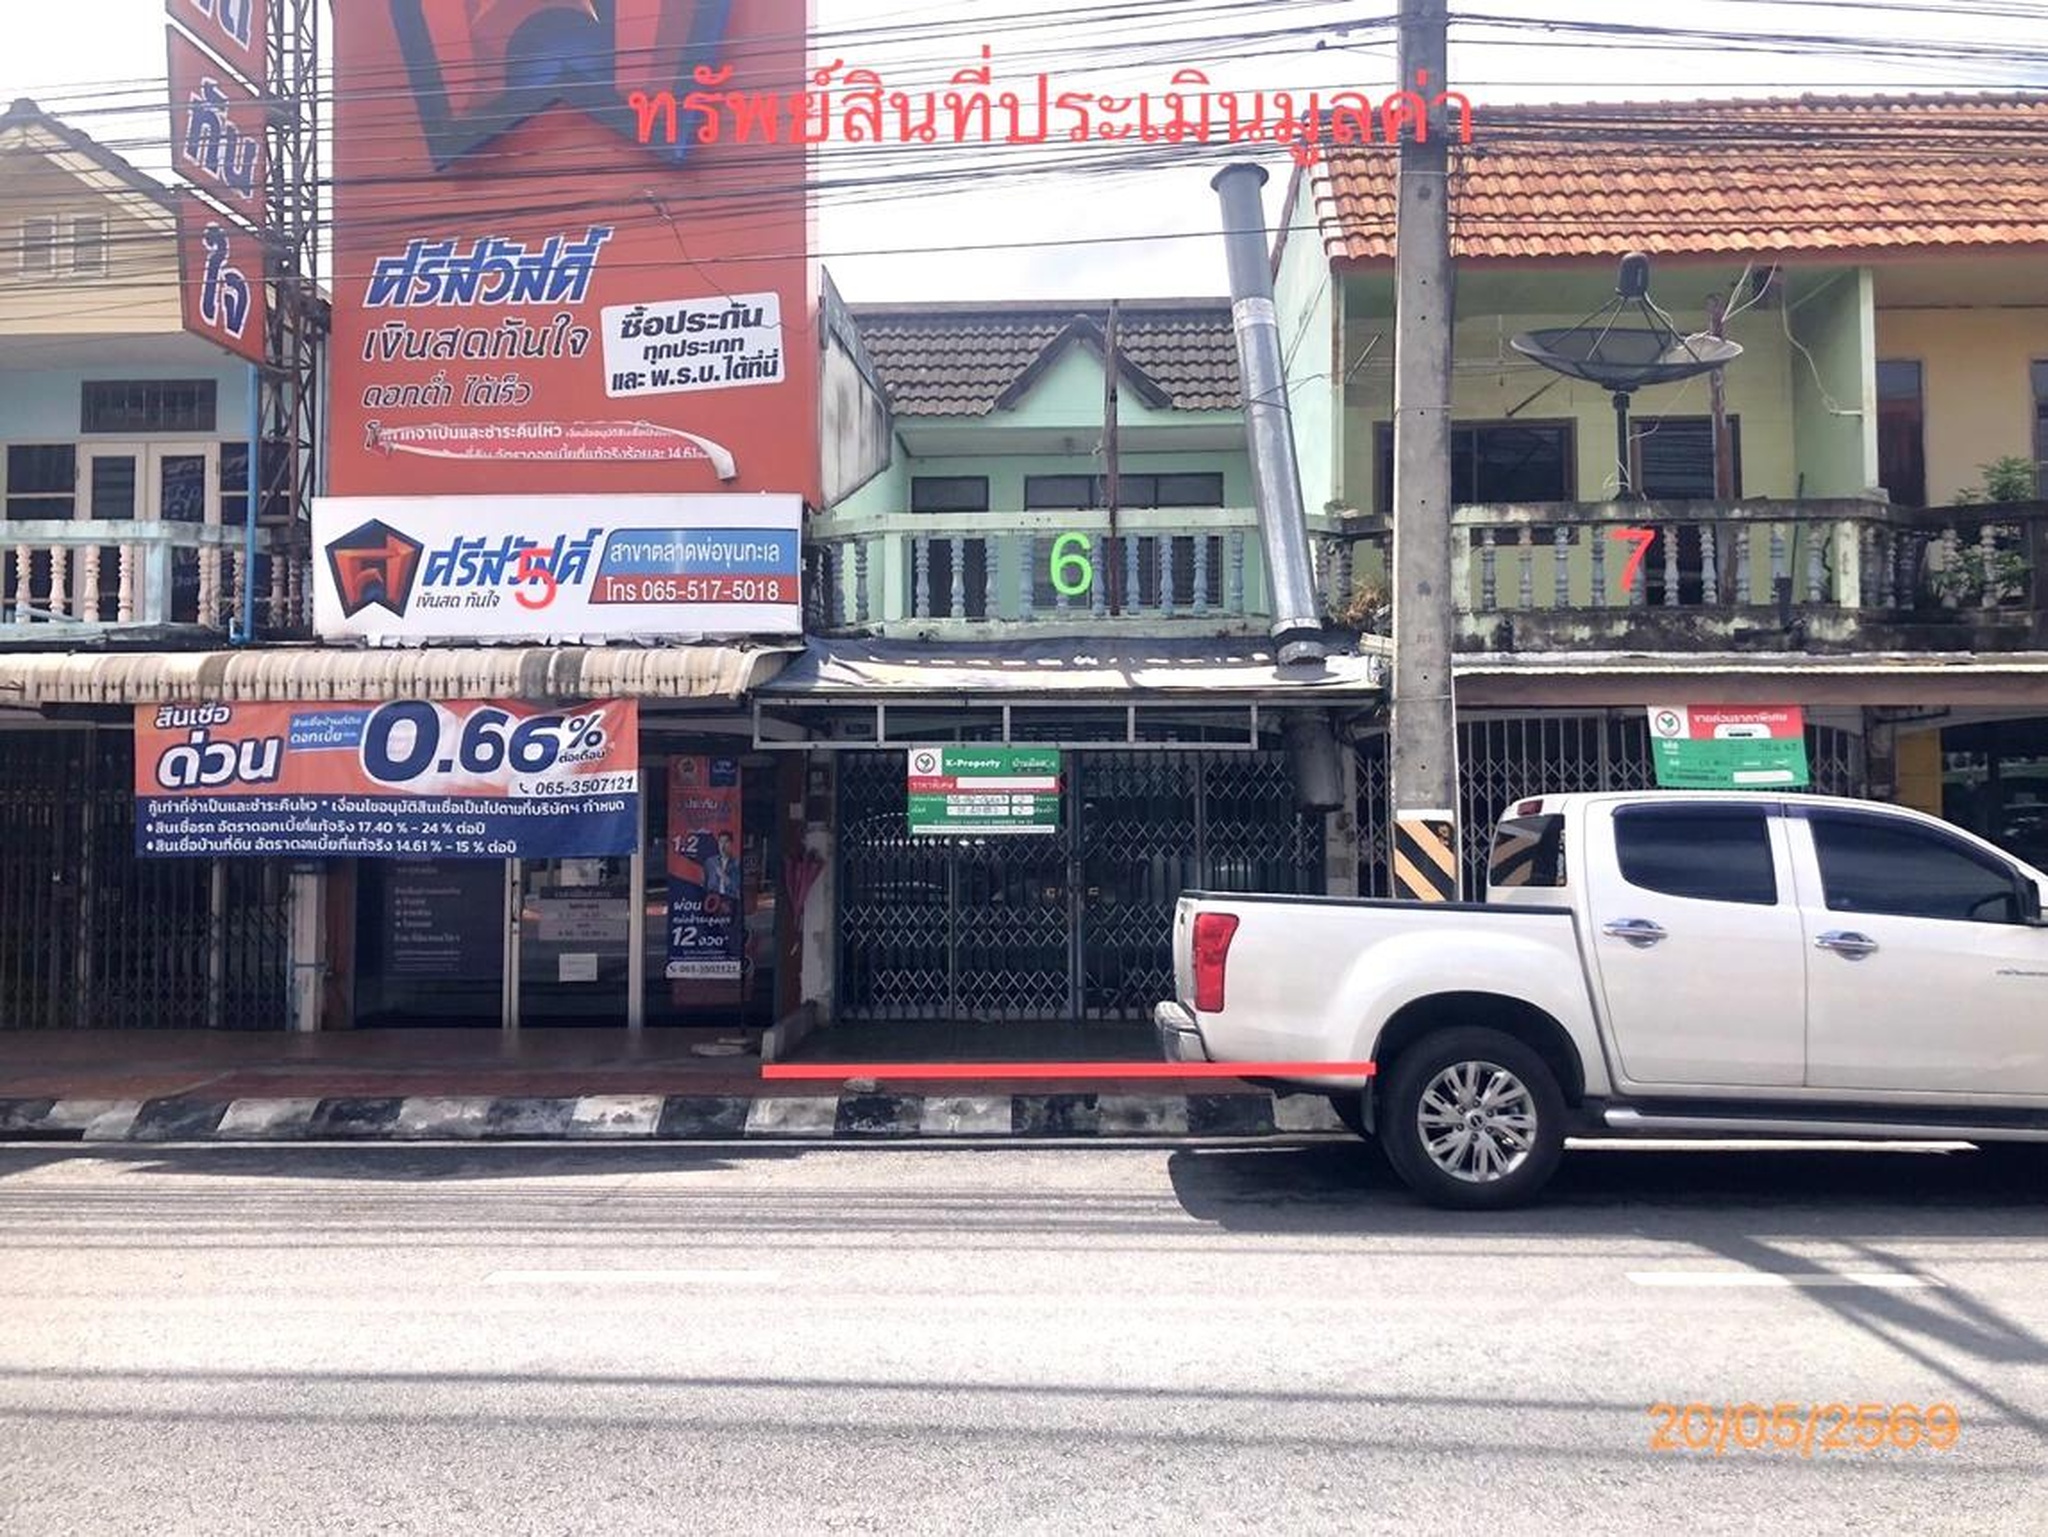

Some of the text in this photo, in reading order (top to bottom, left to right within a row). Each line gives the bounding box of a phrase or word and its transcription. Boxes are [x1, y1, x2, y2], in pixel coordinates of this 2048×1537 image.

[620, 301, 764, 339] ซื้อประกัน
[362, 312, 592, 361] เงินสดทันใจ
[642, 337, 746, 365] ทุกประเภท
[362, 370, 455, 408] ดอกต่ำ
[611, 371, 647, 391] และ
[606, 577, 780, 602] โทร 065-517-5018
[158, 730, 281, 789] ด่วน
[535, 776, 635, 796] 065-3507121
[148, 797, 317, 817] กู้เท่าที่จำเป็นและชำระคืนไว
[358, 821, 393, 834] 17.40
[397, 821, 409, 834] %
[421, 821, 439, 834] 24
[442, 822, 453, 835] %
[456, 821, 486, 836] ต่อปี
[396, 839, 428, 852] 14.61
[430, 840, 443, 853] %
[456, 841, 470, 853] 15
[473, 842, 485, 854] %
[487, 840, 518, 855] ต่อปี
[672, 926, 698, 946] 12
